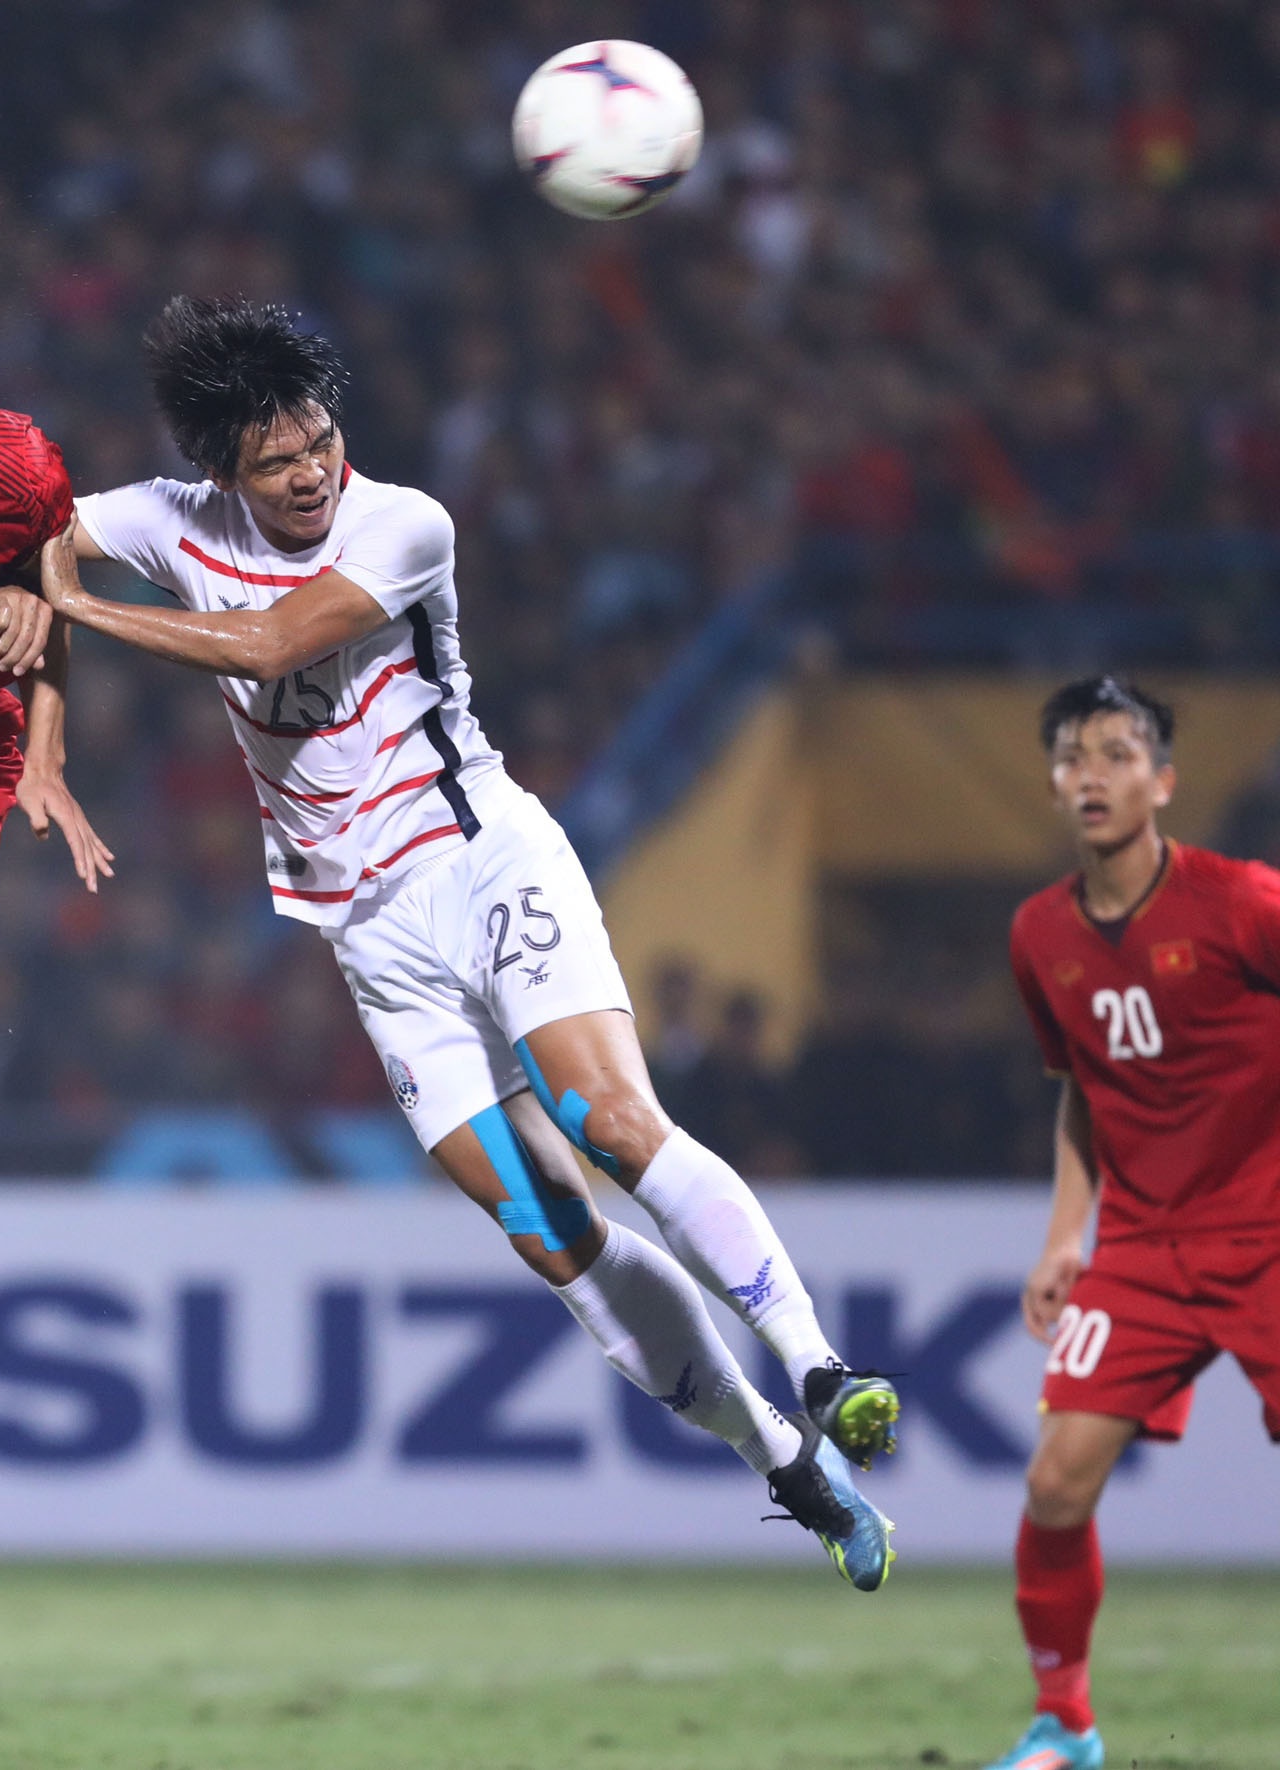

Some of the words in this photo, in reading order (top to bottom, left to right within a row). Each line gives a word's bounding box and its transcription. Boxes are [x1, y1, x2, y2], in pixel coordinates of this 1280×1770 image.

[486, 885, 561, 975] 25
[1091, 985, 1163, 1060] 20
[1045, 1304, 1112, 1379] 20
